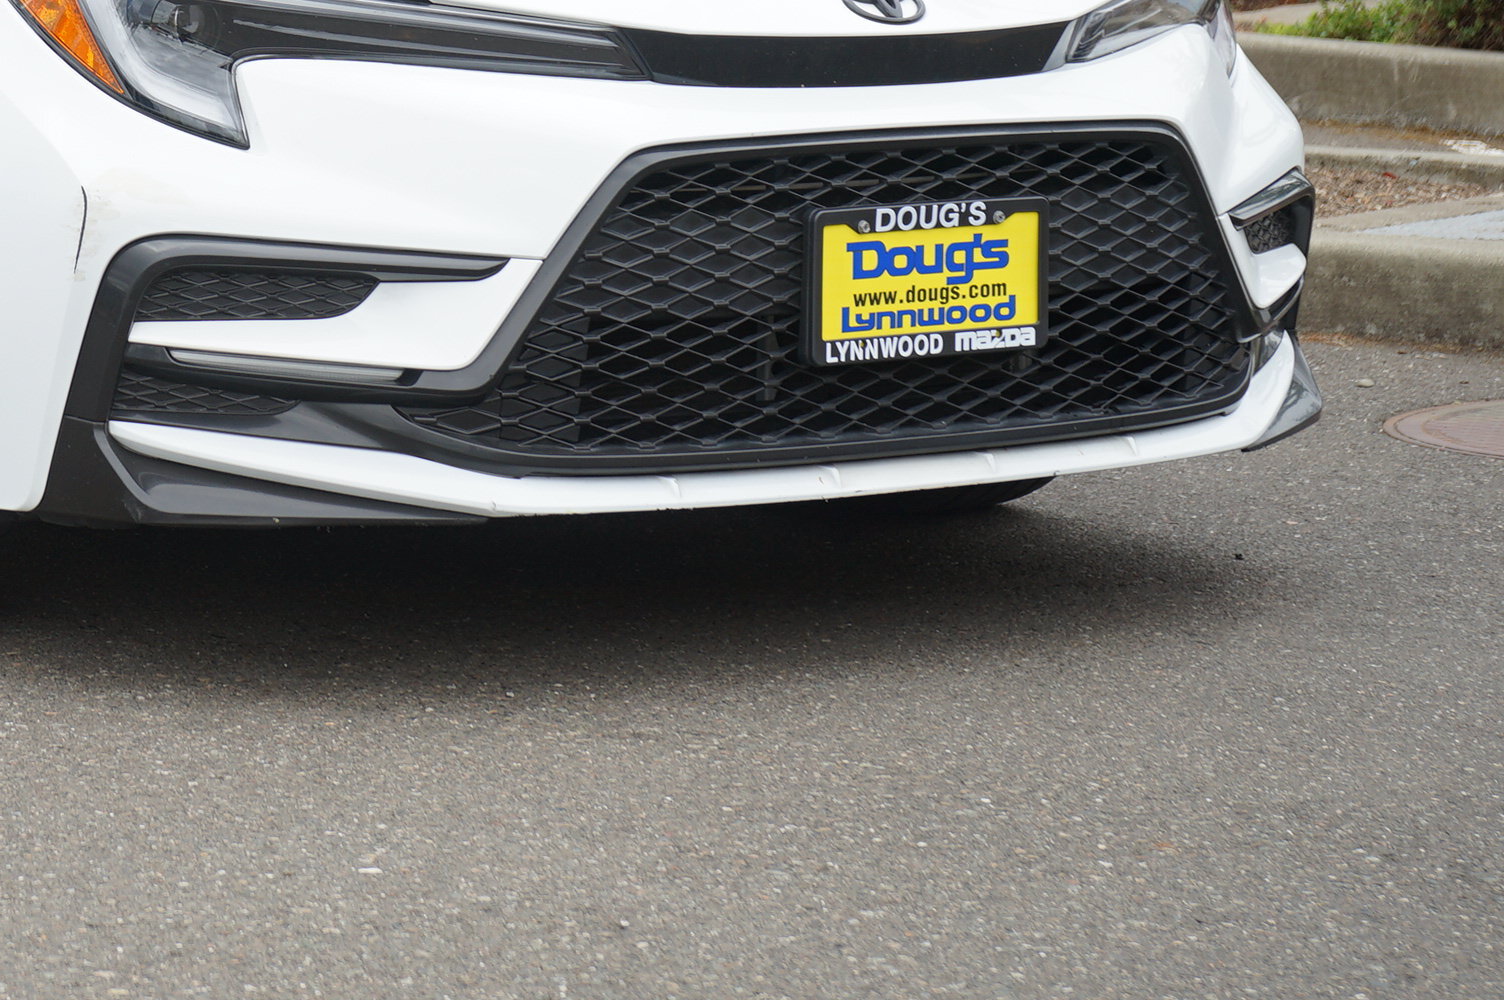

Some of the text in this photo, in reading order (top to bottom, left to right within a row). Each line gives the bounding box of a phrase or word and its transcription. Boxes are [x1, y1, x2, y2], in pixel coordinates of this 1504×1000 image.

[875, 201, 987, 233] DOUG'S
[846, 233, 1010, 285] Doug's
[853, 282, 1007, 307] www.dougs.com
[841, 294, 1016, 333] Lynnwood
[825, 333, 944, 364] LYNNWOOD
